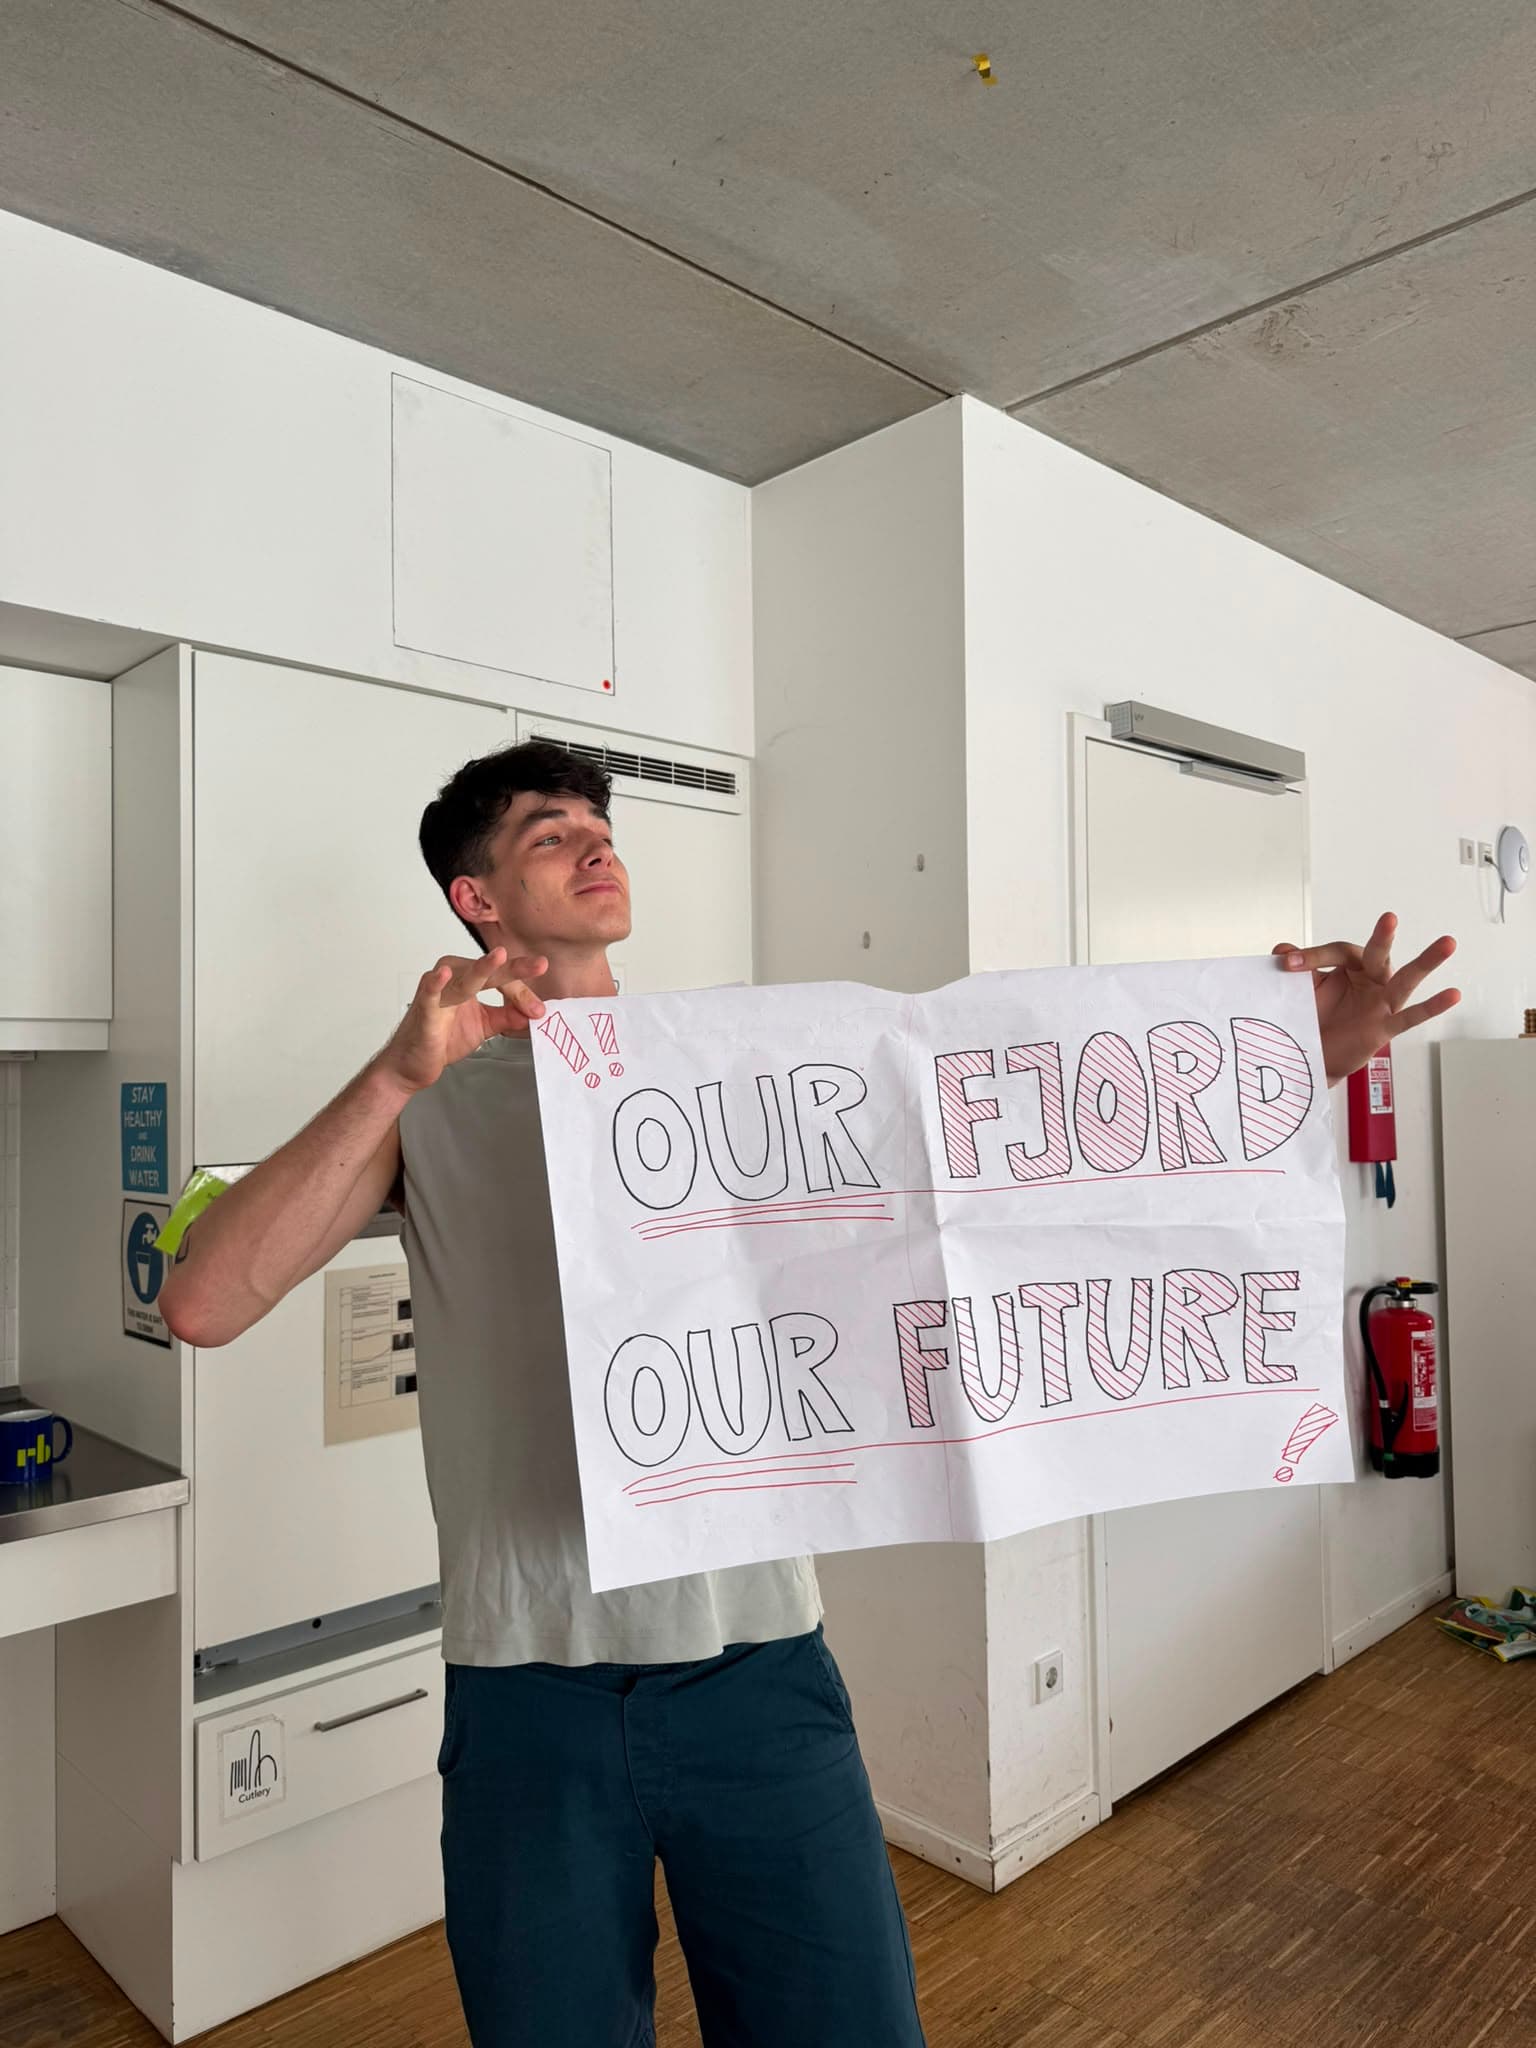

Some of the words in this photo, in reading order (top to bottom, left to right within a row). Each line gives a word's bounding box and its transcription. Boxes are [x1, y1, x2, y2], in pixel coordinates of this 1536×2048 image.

[131, 1086, 156, 1103] STAY
[124, 1109, 163, 1128] HEALTHY
[612, 1063, 881, 1210] OUR
[935, 1017, 1314, 1182] FJORD
[130, 1145, 157, 1162] DRINK
[128, 1169, 160, 1187] WATER
[604, 1312, 855, 1467] OUR
[893, 1268, 1300, 1427] FUTURE
[238, 1787, 271, 1803] Cutlery
